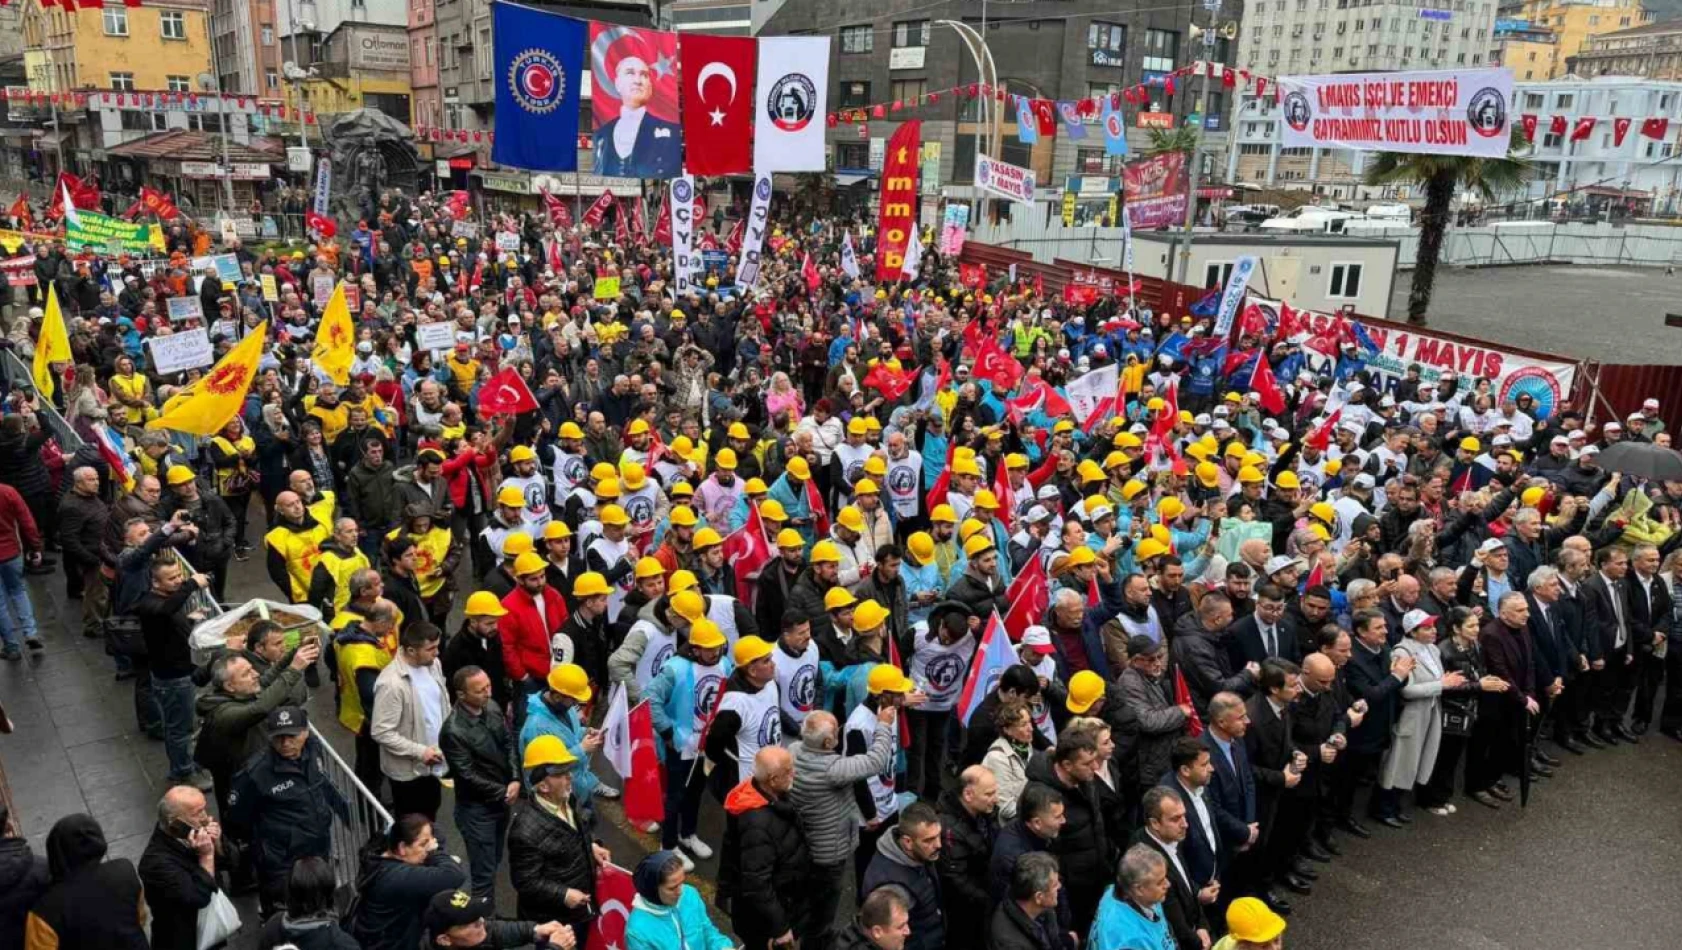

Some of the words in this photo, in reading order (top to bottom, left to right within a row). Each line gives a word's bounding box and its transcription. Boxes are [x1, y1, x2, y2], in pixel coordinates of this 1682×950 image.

[362, 34, 407, 49] Ottoman
[1316, 85, 1324, 107] 1
[1325, 84, 1360, 107] MAYIS
[1390, 82, 1404, 106] VE
[1408, 75, 1457, 111] EMEKÇİ
[1313, 117, 1383, 141] BAYRAMIMIZ
[1384, 119, 1421, 142] KUTLU
[1424, 119, 1468, 145] OLSUN
[996, 176, 1021, 195] MAYIS
[884, 145, 912, 268] tmmob
[675, 208, 691, 290] ÇYDD
[1394, 333, 1409, 358] 1
[1414, 336, 1504, 379] MAYIS
